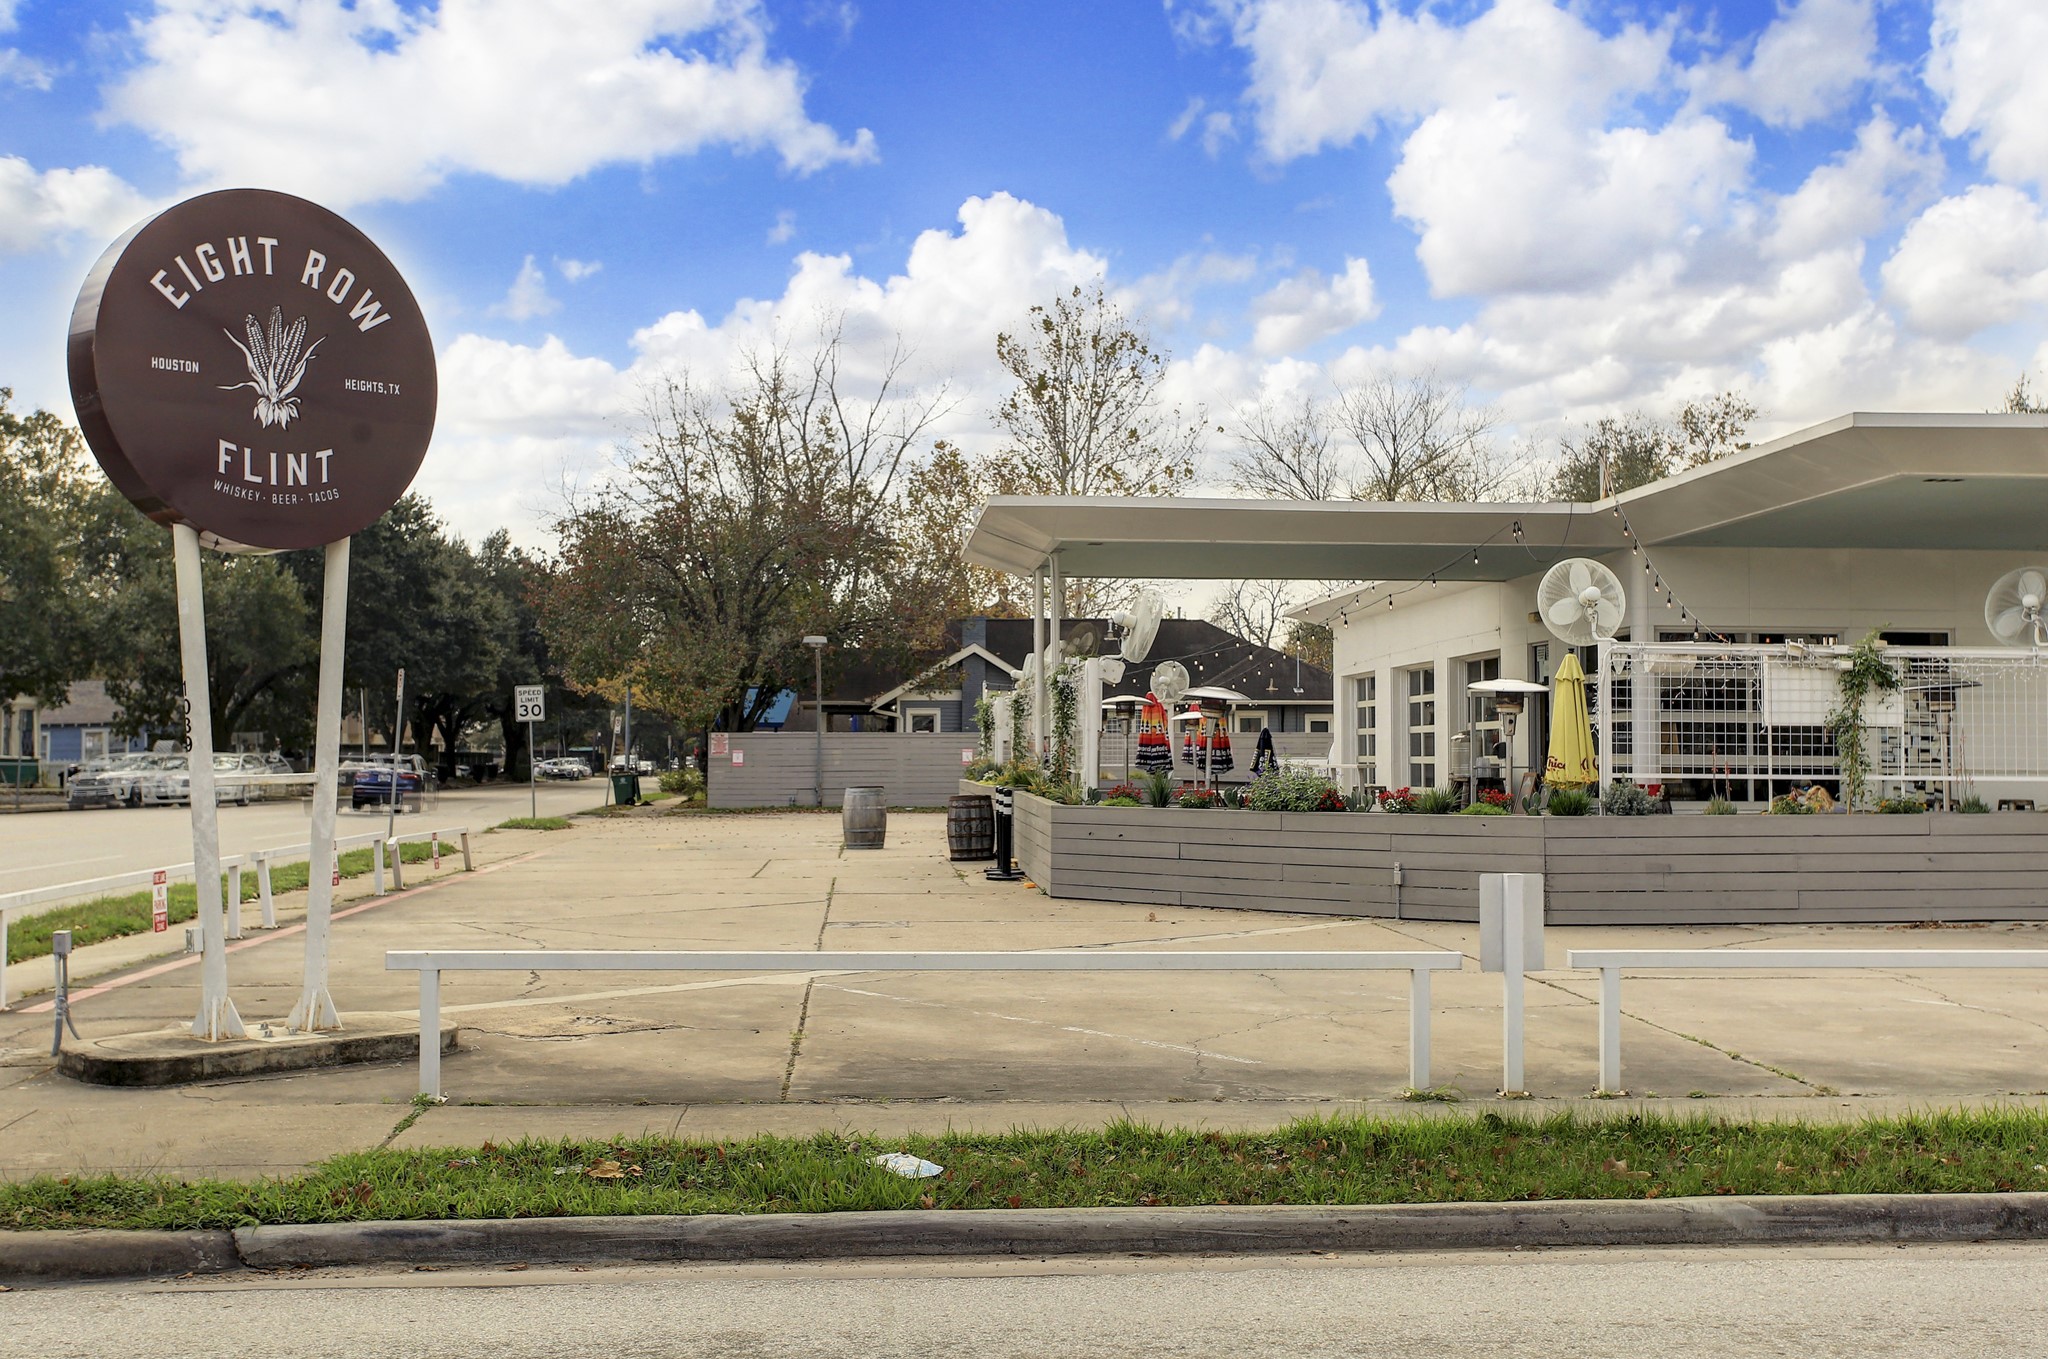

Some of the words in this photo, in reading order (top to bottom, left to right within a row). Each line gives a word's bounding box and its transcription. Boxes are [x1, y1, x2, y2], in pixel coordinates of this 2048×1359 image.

[150, 236, 279, 310] EIGHT
[300, 248, 391, 333] ROW
[151, 356, 199, 374] HOUSTON
[344, 378, 388, 395] HEIGHTS,
[388, 383, 401, 395] TX
[217, 438, 334, 487] FLINT
[213, 479, 261, 502] WHISKEY
[271, 493, 298, 505] BEER
[308, 488, 340, 503] TACOS
[519, 704, 541, 717] 30
